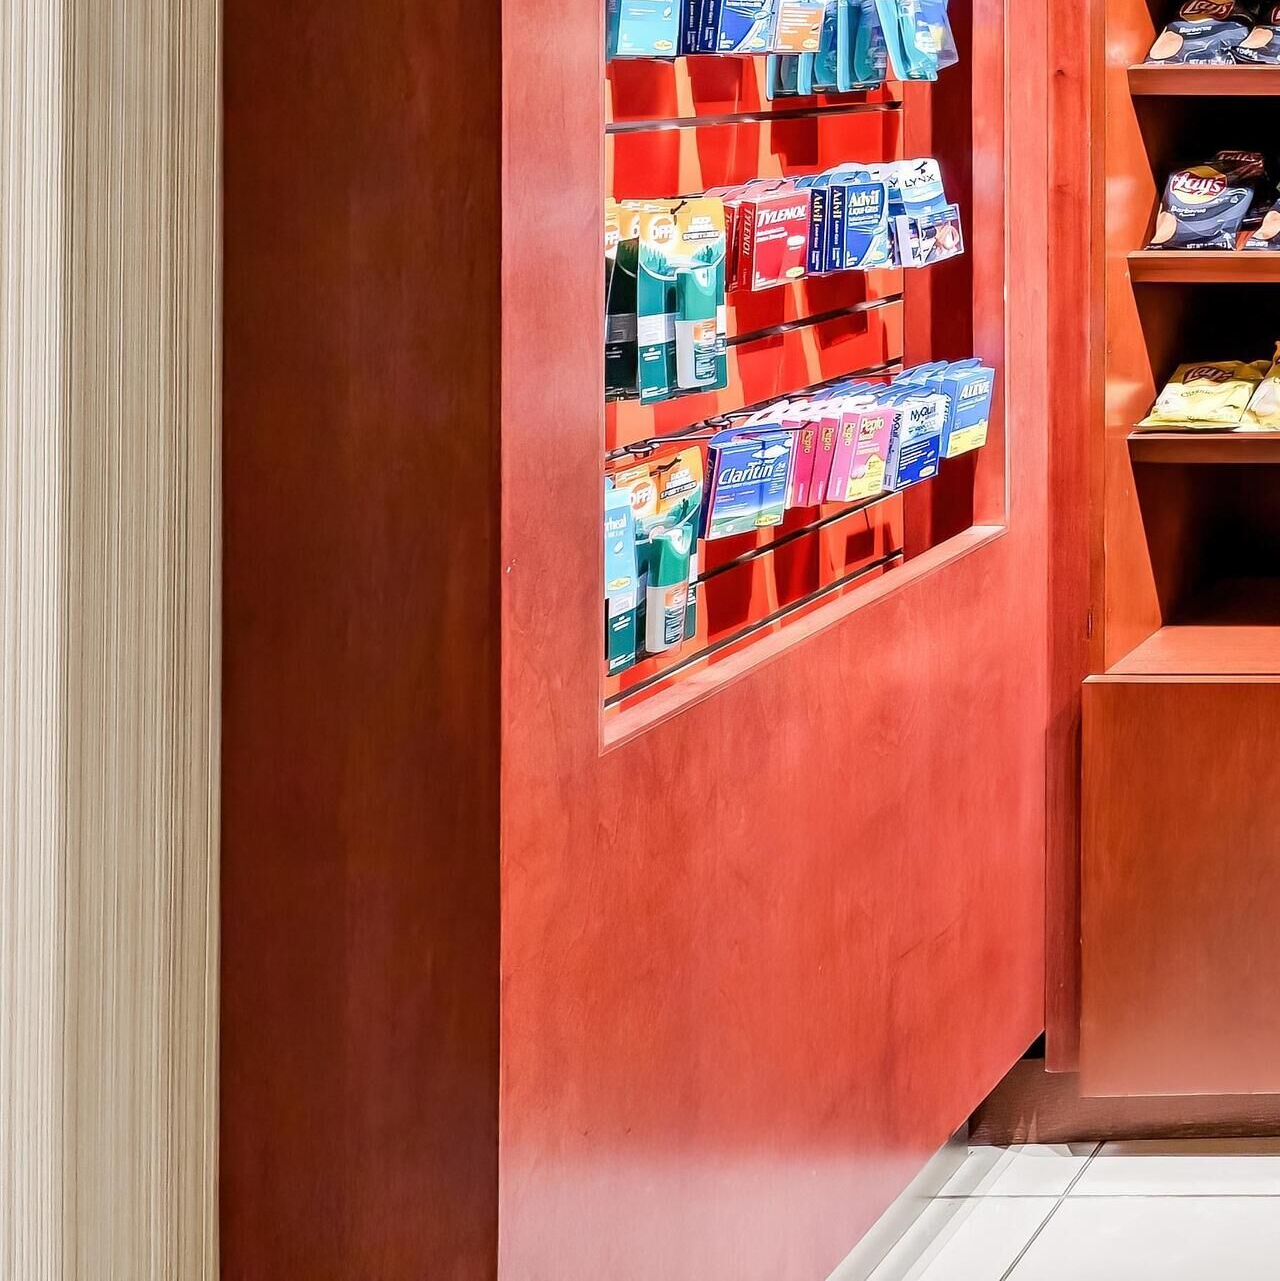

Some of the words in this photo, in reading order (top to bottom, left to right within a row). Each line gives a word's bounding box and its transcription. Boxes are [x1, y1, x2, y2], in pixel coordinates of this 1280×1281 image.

[904, 174, 935, 187] LYNX
[1173, 174, 1224, 195] Lay's
[813, 193, 823, 222] Advil
[832, 189, 843, 219] Advil
[849, 190, 880, 207] Advil
[757, 205, 807, 227] TYLENOL
[910, 403, 937, 421] NyQuil
[843, 422, 856, 446] Pepto
[861, 417, 884, 433] Pepto
[822, 427, 835, 451] Pepto
[719, 462, 774, 486] Claritin
